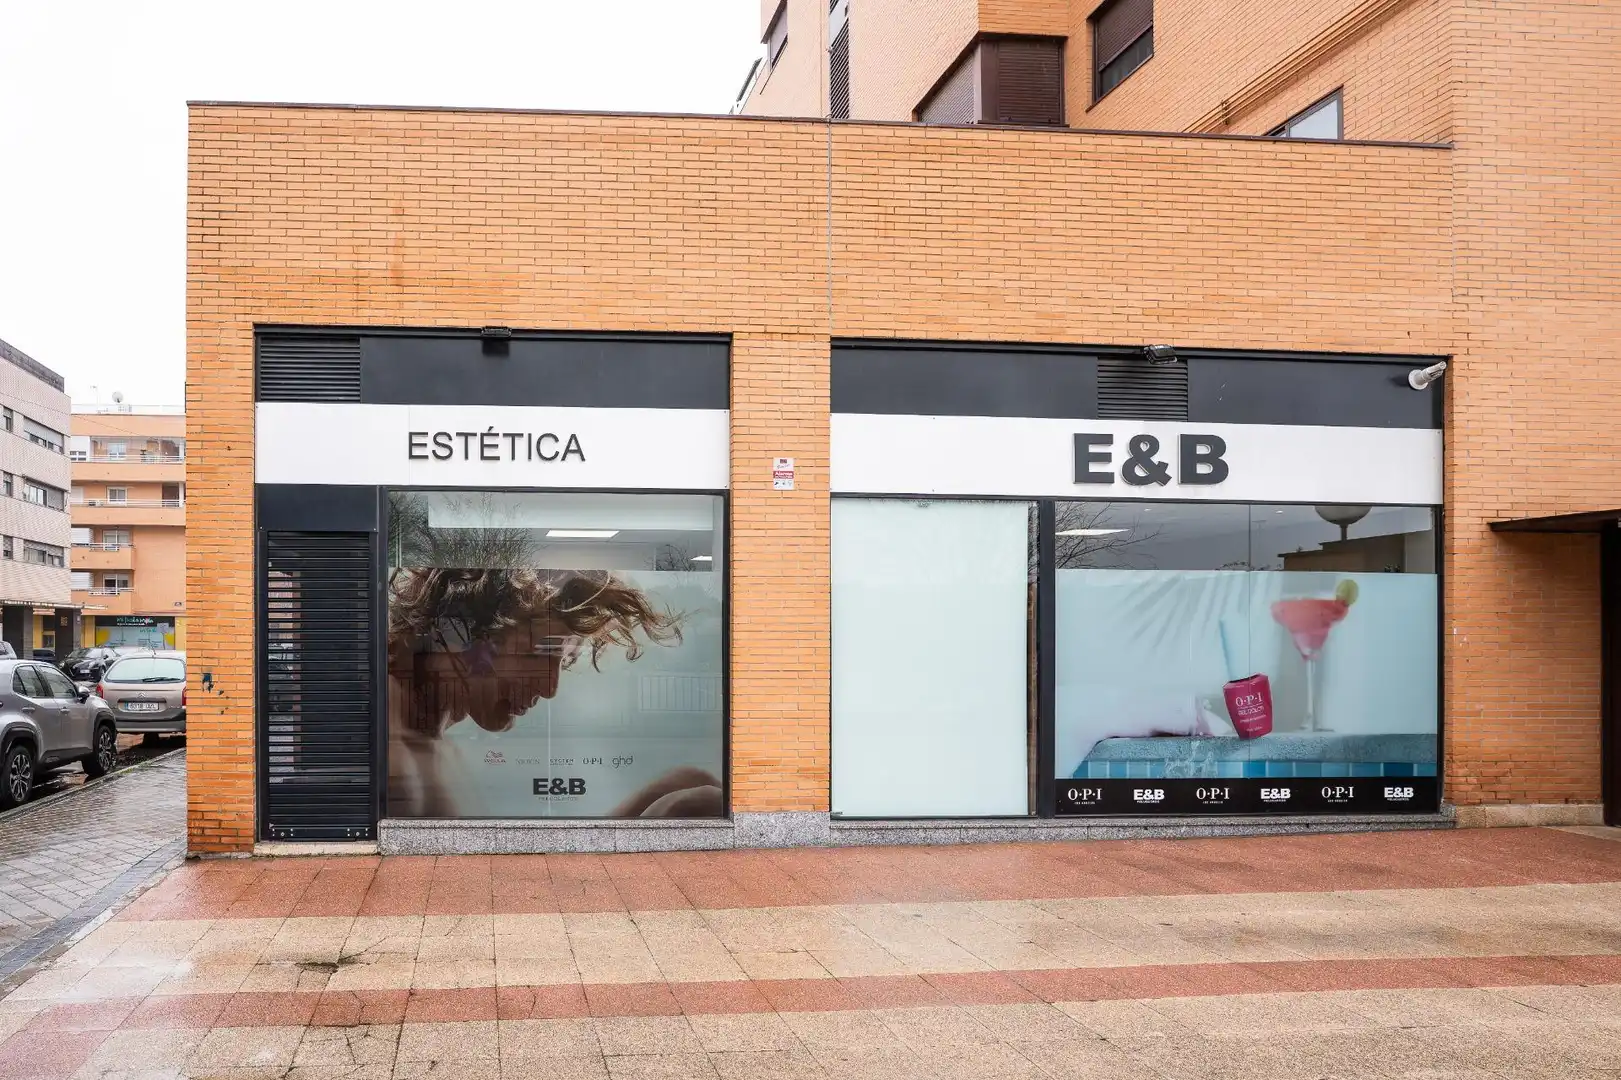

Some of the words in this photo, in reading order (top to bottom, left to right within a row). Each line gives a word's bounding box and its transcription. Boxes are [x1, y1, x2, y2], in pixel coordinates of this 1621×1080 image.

[408, 426, 586, 462] ESTÉTICA
[1073, 432, 1229, 487] E&B
[612, 755, 634, 769] ghd
[533, 778, 587, 795] E&B
[1260, 788, 1291, 799] E&B
[1383, 786, 1414, 798] E&B
[1133, 788, 1165, 801] E&B
